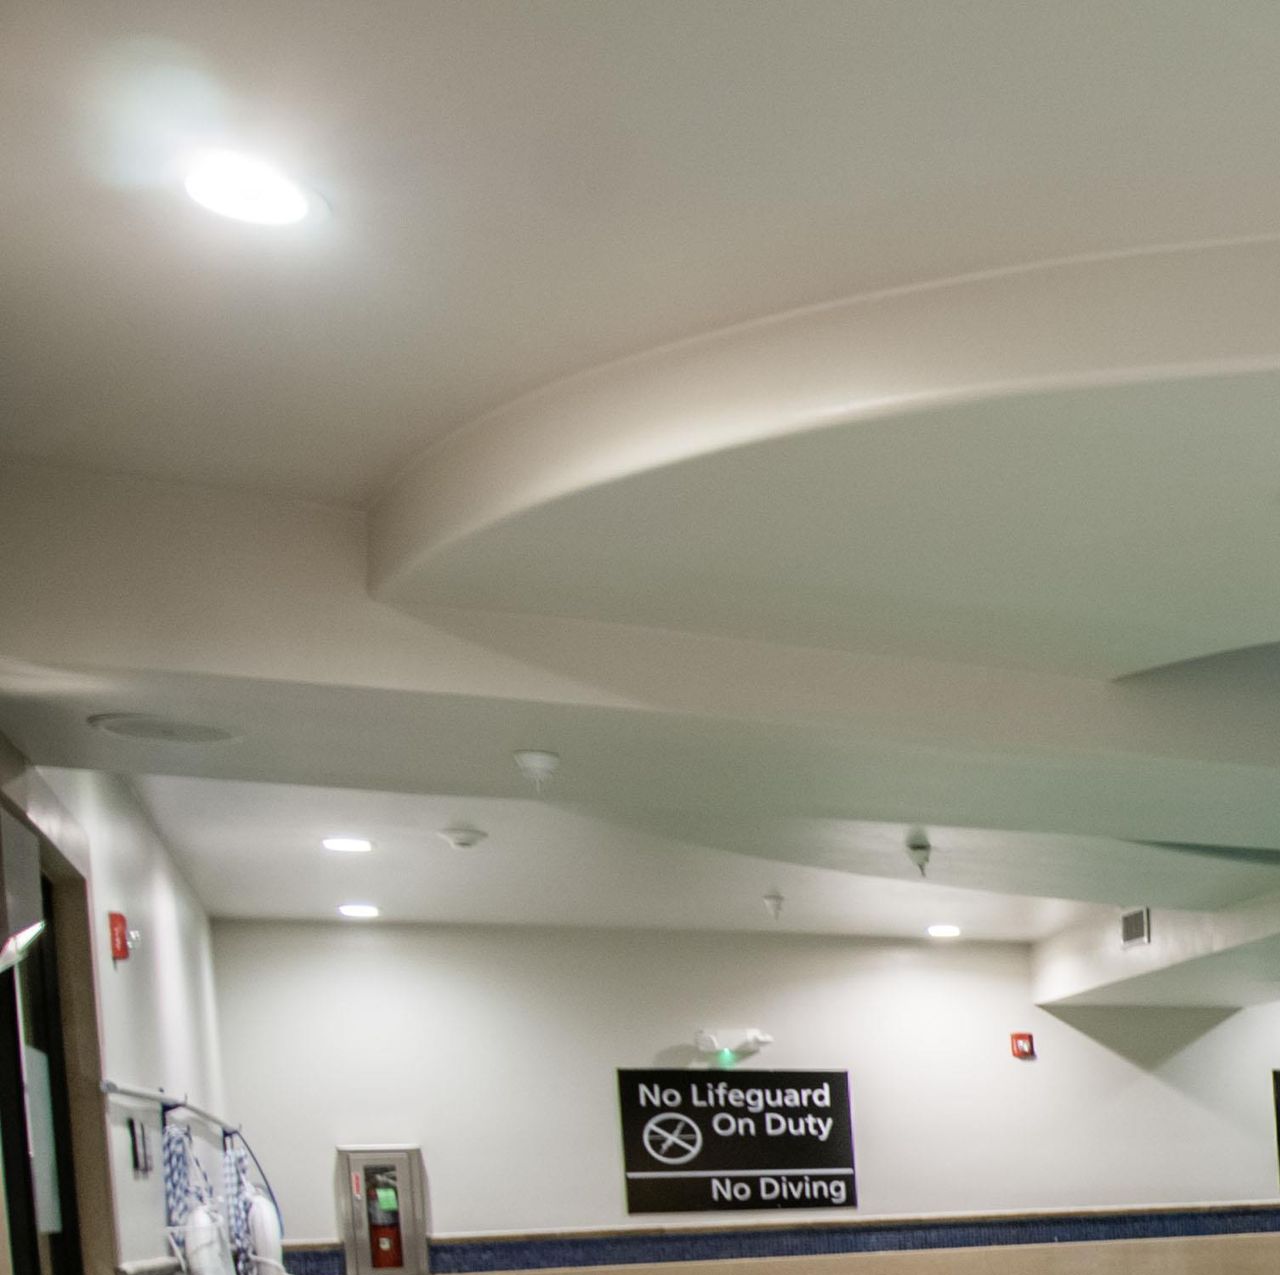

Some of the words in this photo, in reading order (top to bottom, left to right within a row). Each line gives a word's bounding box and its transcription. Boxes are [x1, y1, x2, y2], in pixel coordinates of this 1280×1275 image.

[638, 1083, 682, 1107] No
[691, 1082, 831, 1113] Lifeguard
[712, 1112, 756, 1137] On
[765, 1112, 833, 1141] Duty
[711, 1178, 751, 1202] No
[760, 1176, 846, 1203] Diving
